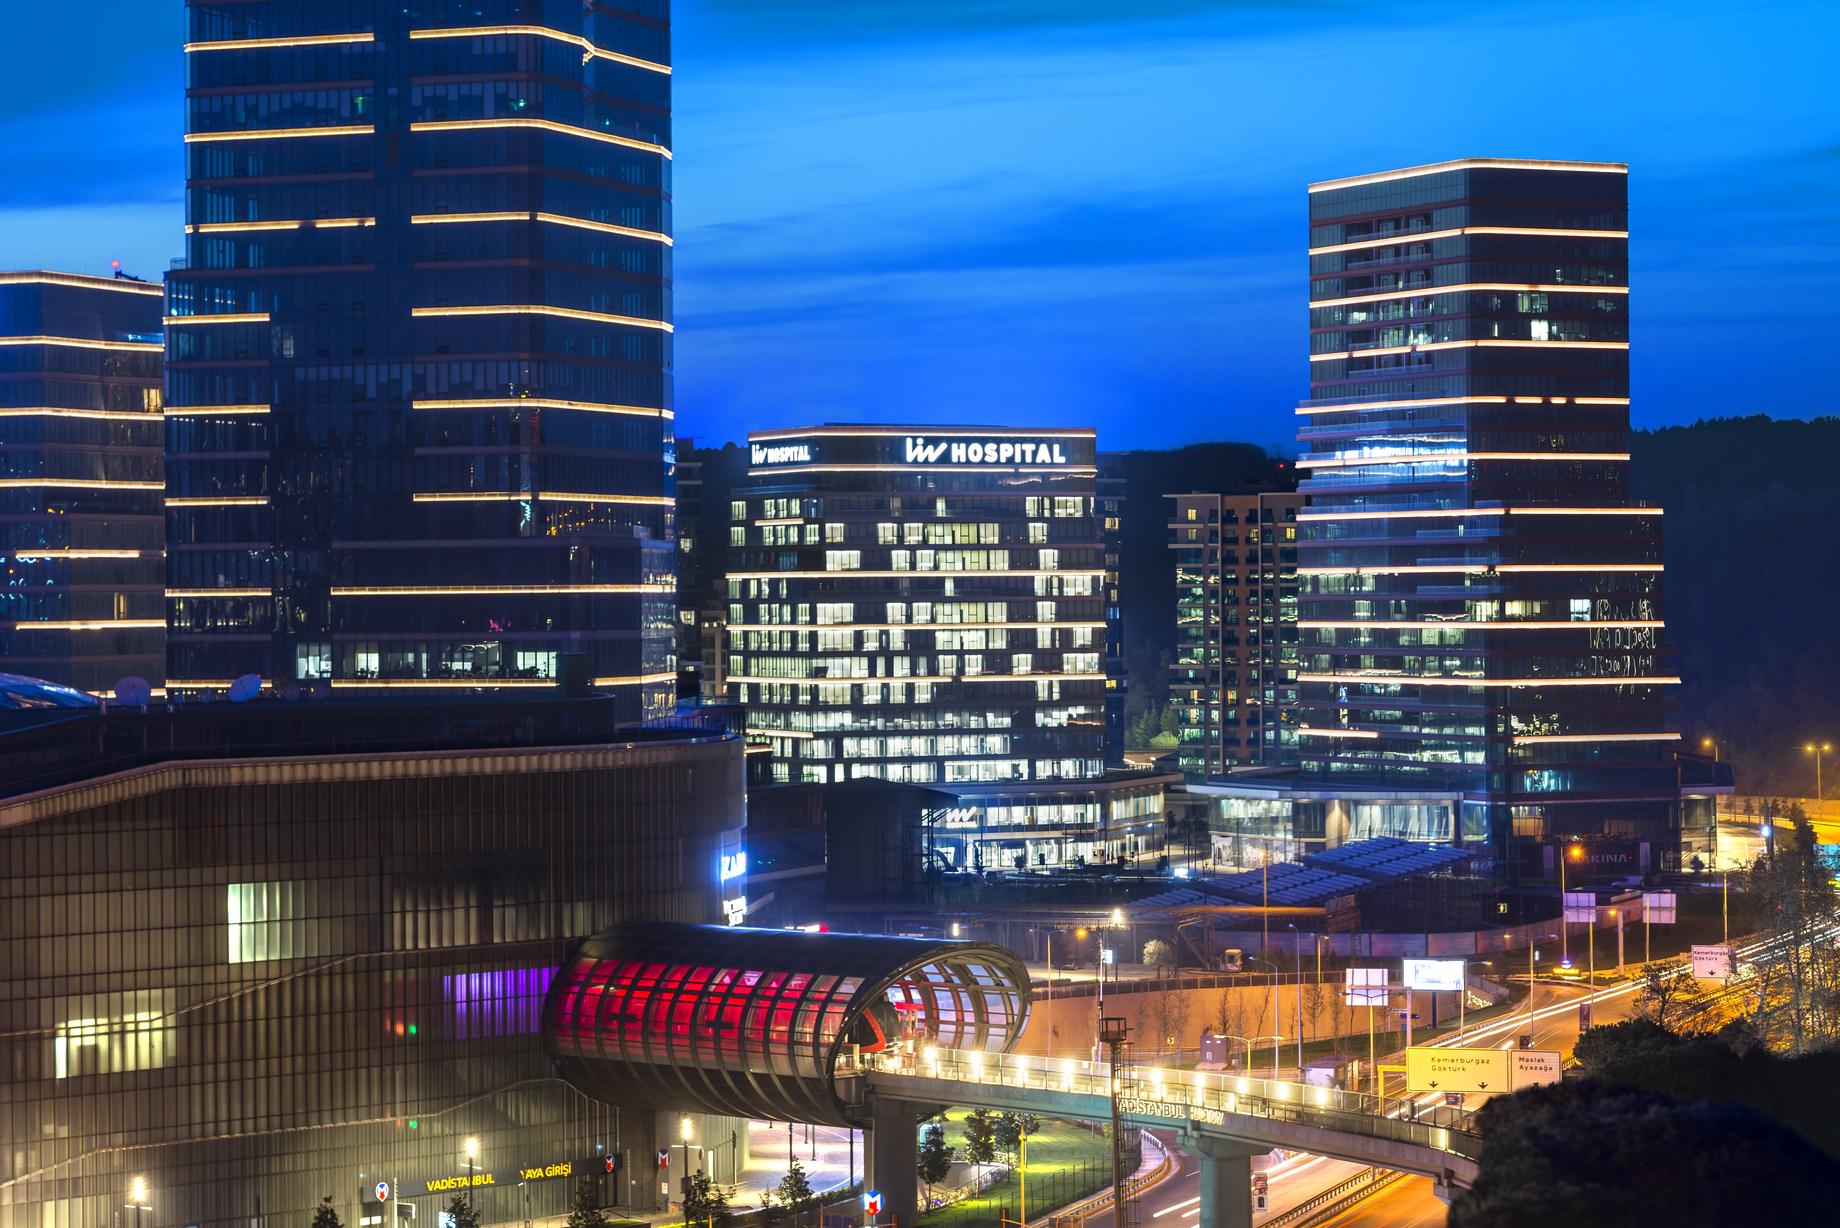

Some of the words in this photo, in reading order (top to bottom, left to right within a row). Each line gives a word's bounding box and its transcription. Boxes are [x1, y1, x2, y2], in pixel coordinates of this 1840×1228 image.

[767, 445, 811, 463] HOSPITAL
[951, 442, 1067, 463] HOSPITAL
[1431, 1057, 1491, 1065] Kemerburgaz
